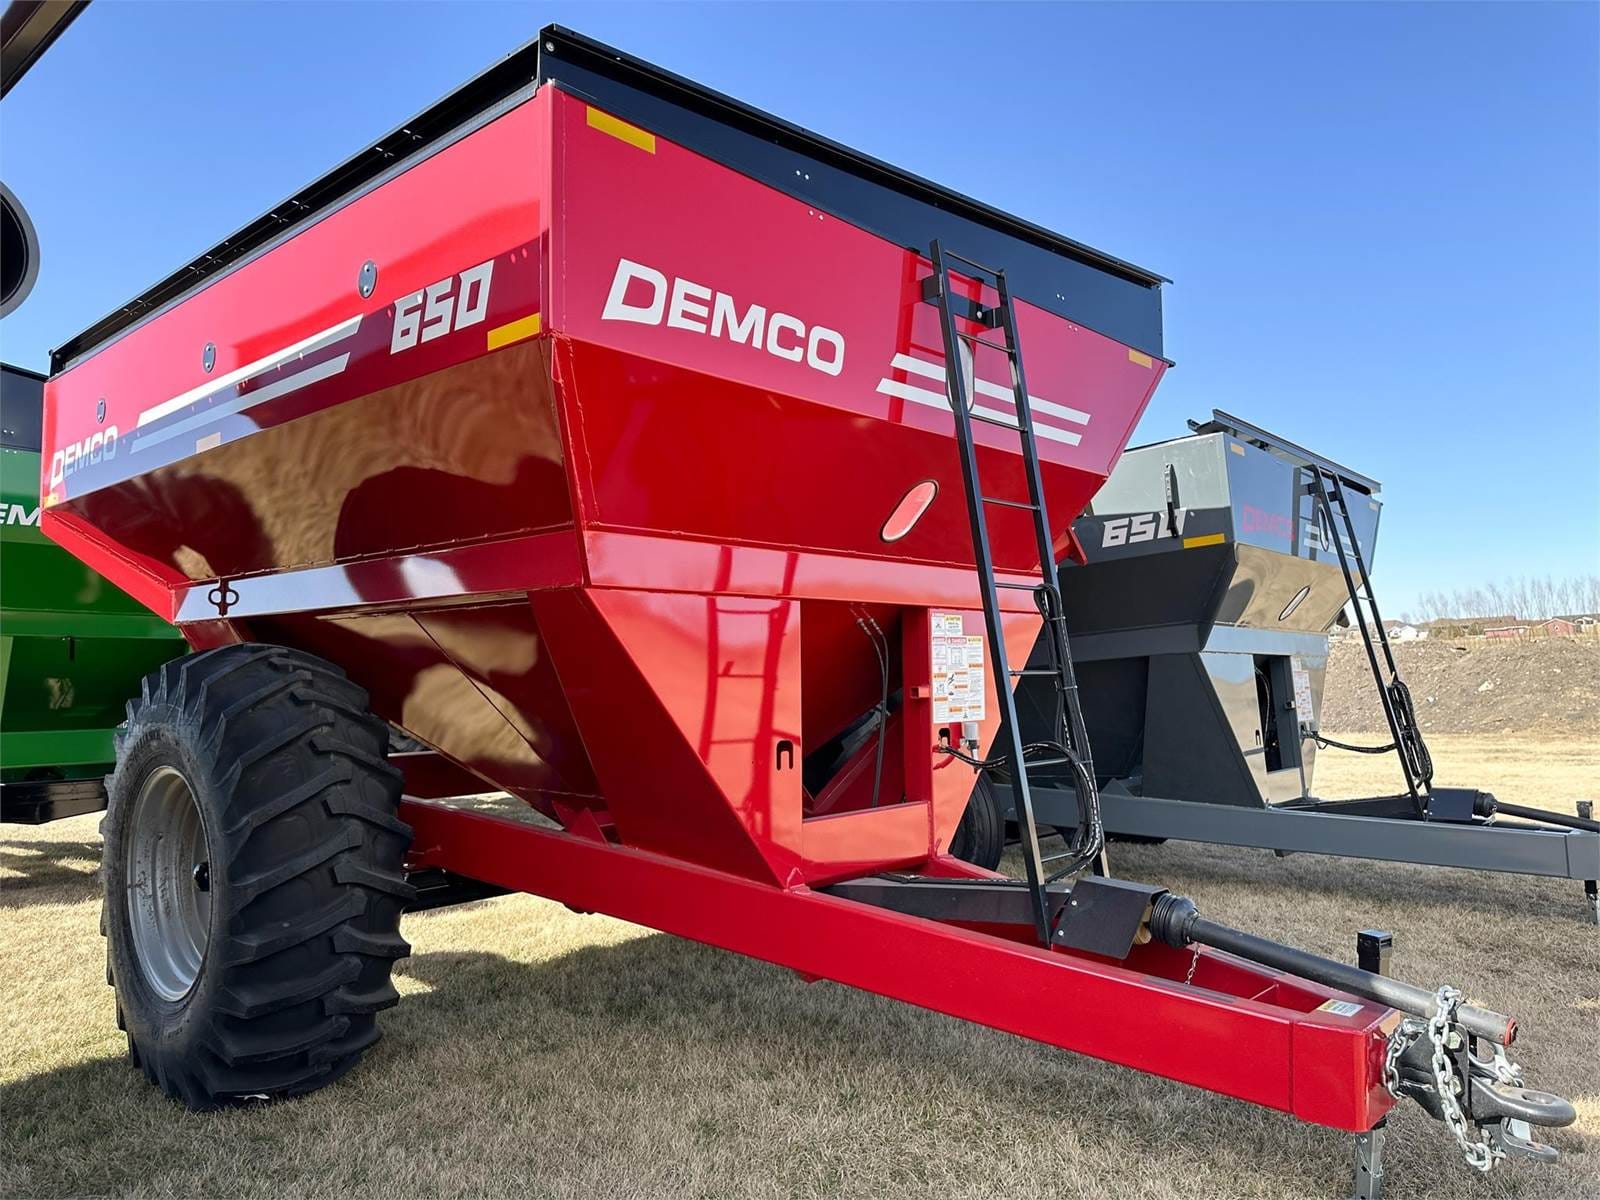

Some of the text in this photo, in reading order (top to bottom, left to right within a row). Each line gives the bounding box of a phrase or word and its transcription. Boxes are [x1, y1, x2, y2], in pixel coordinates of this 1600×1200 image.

[390, 259, 495, 355] 650
[601, 258, 845, 377] DEMCO
[50, 425, 118, 489] DEMCO
[1102, 507, 1187, 548] 650
